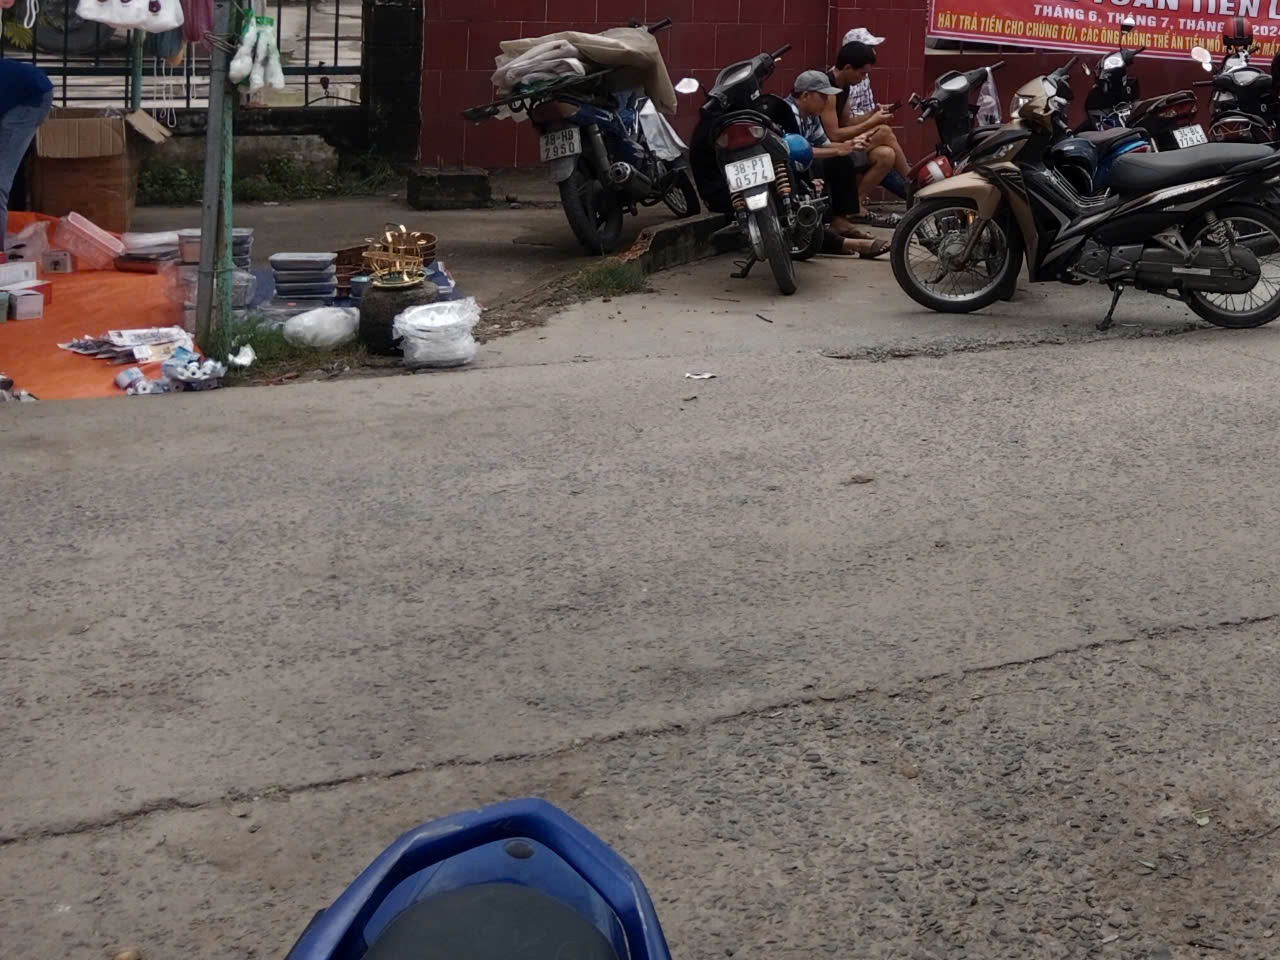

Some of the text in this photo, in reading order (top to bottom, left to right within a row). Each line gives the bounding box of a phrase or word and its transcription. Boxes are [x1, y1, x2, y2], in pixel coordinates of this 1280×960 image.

[1033, 4, 1085, 21] THÁNG
[937, 10, 958, 29] HÃY
[959, 11, 978, 31] TRẢ
[980, 14, 1002, 33] TIỀN
[1004, 19, 1024, 36] CHO
[1025, 20, 1058, 39] CHÚNG
[1080, 25, 1099, 43] CÁC
[1101, 27, 1120, 44] ÔNG
[1153, 28, 1170, 49] THỂ
[732, 158, 765, 176] 38-P1
[735, 169, 768, 189] 0574
